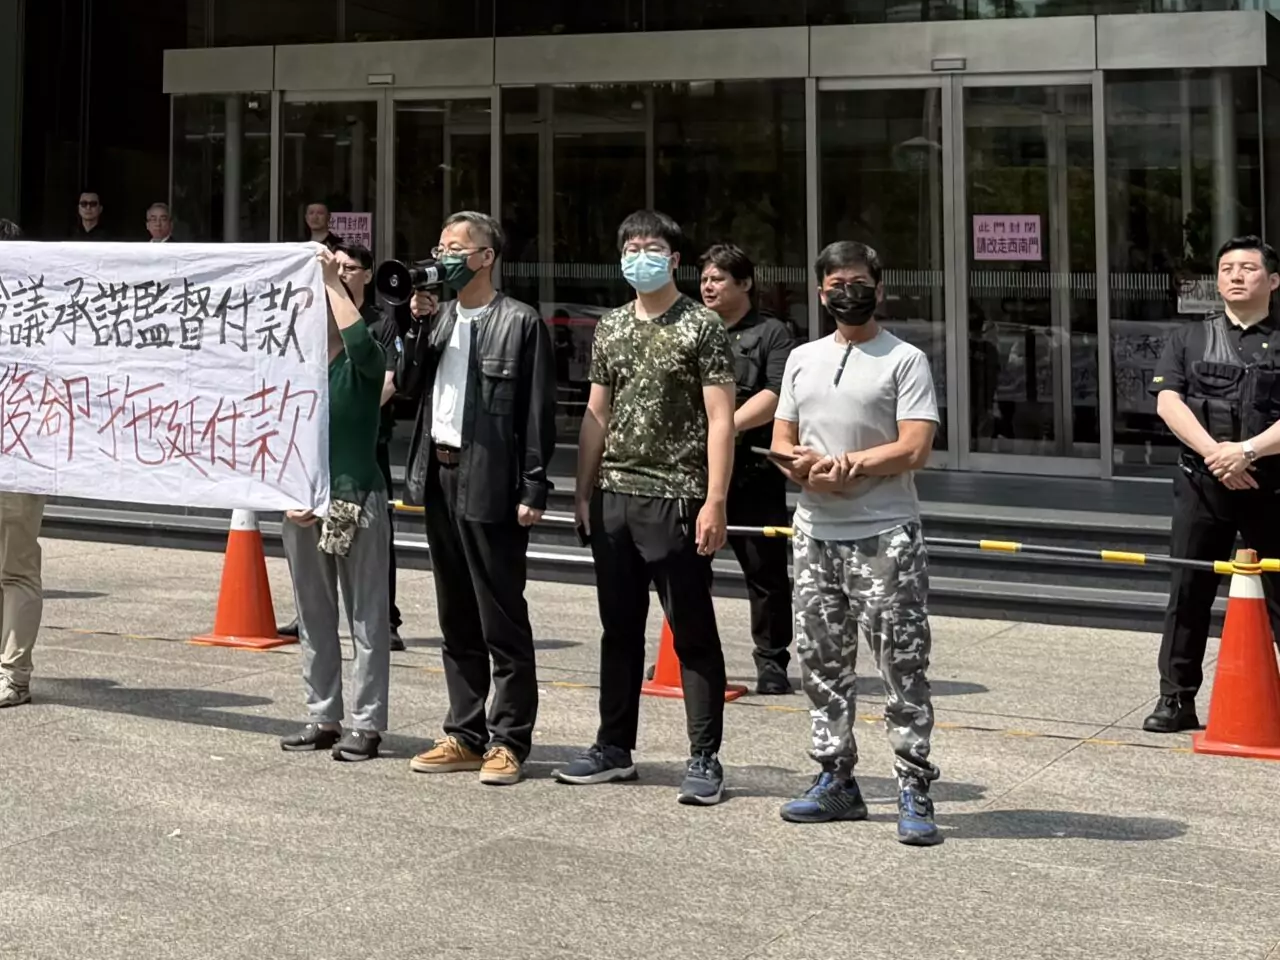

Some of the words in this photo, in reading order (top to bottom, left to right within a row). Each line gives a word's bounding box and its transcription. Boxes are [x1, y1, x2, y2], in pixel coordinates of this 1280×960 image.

[978, 221, 1036, 234] 此門封閉
[976, 237, 1039, 254] 請改走西南門
